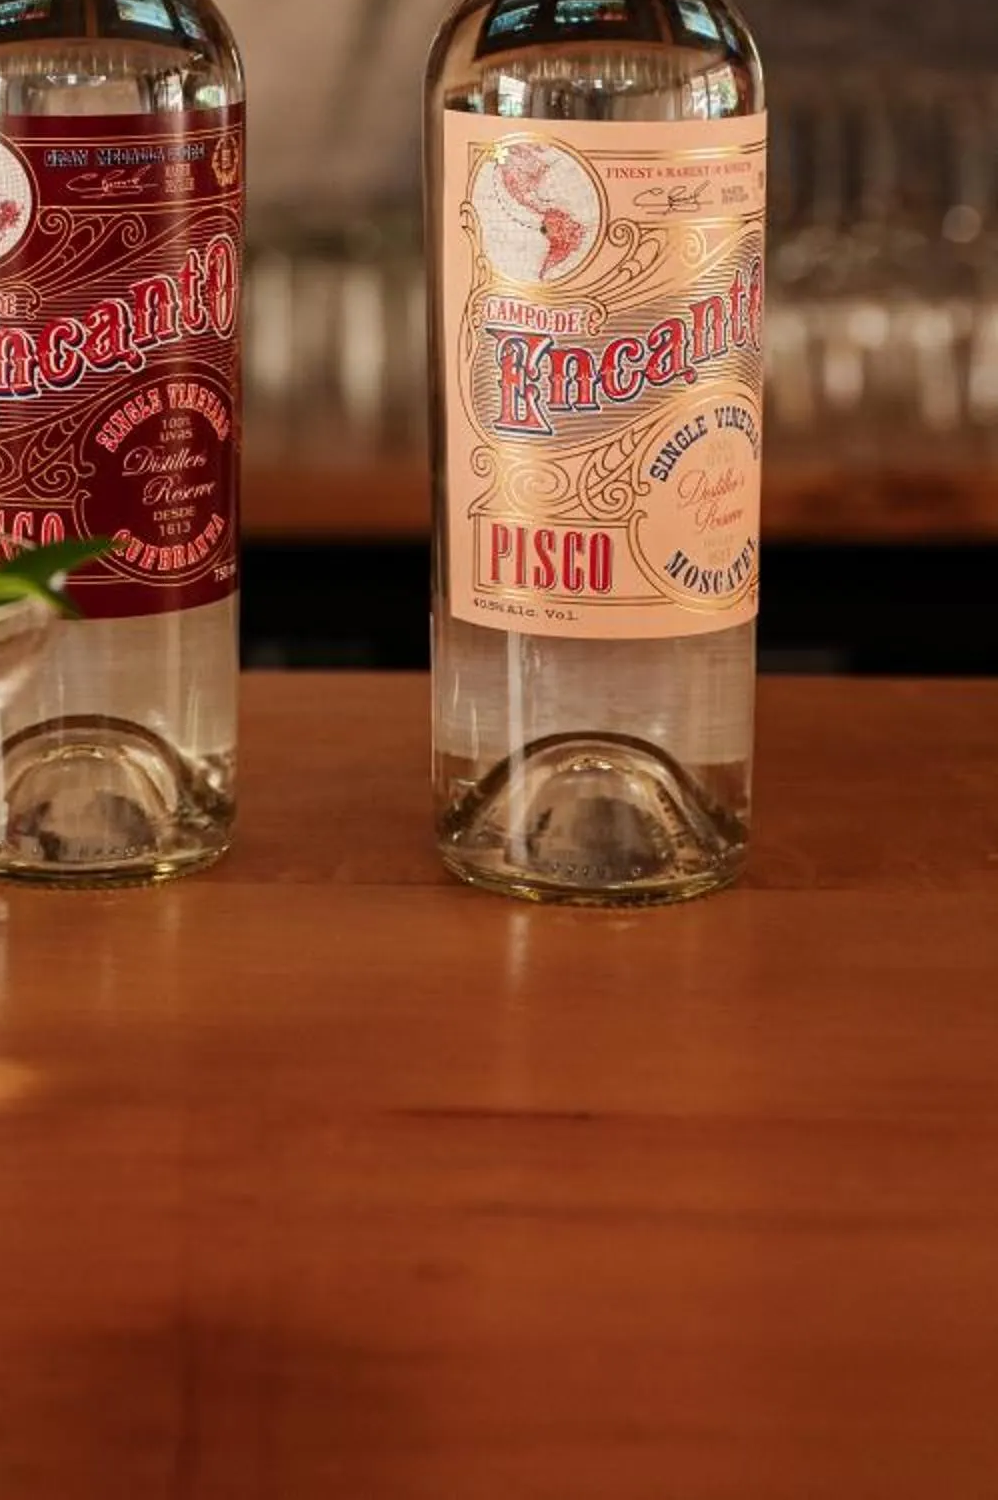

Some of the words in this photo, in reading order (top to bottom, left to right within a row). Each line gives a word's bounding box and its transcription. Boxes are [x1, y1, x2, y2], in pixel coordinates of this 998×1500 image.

[606, 167, 653, 179] FINEST
[486, 299, 547, 329] CAMPO
[553, 310, 579, 332] DE
[650, 416, 707, 482] SINGLE
[153, 505, 195, 521] DESDE
[491, 522, 615, 595] PISCO
